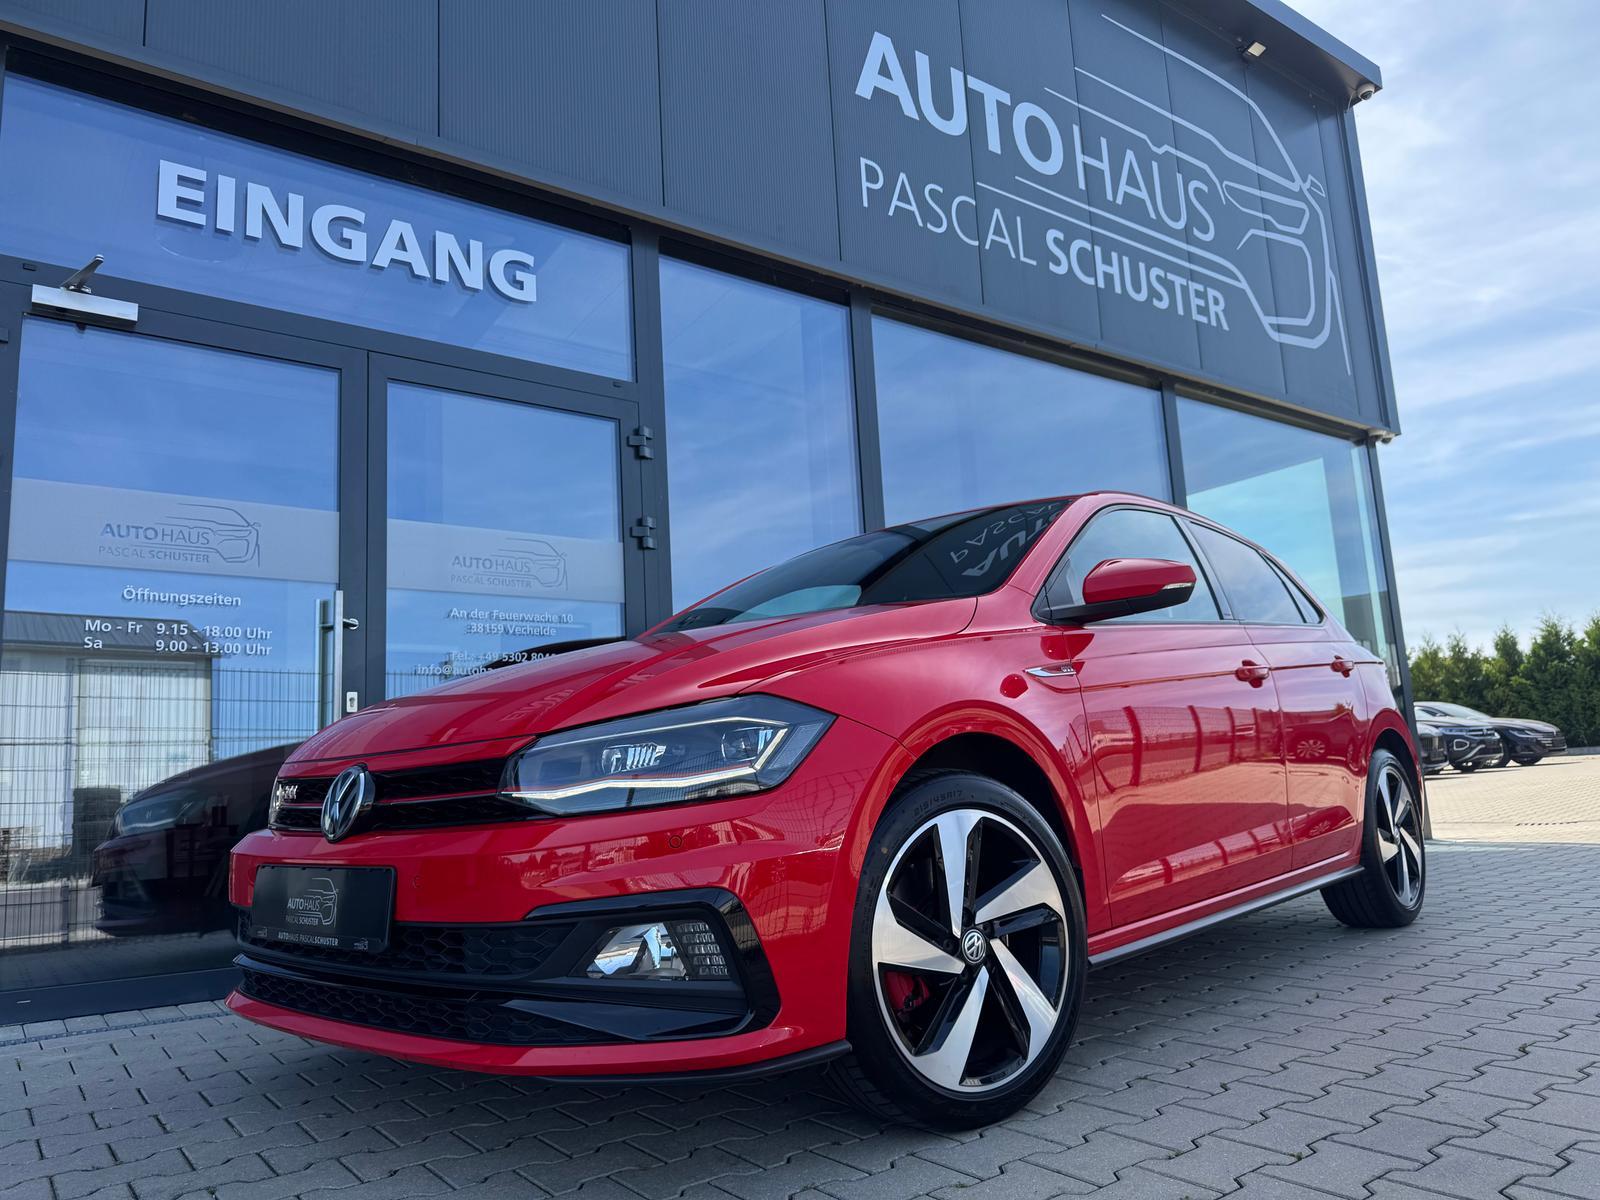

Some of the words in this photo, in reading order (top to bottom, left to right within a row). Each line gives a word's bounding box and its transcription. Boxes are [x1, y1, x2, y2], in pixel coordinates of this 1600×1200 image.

[157, 159, 537, 302] EINGANG
[860, 157, 1037, 267] PASCAL
[1046, 229, 1229, 331] SCHUSTER
[99, 545, 145, 559] PASCAL
[149, 550, 210, 564] SCHUSTER
[451, 574, 484, 585] PASCAL
[487, 577, 532, 588] SCHUSTER
[123, 585, 241, 609] Öffnungszeiten
[451, 607, 467, 619] An
[470, 608, 490, 620] der
[493, 609, 559, 623] Feuerwache
[561, 613, 574, 624] 10
[85, 619, 112, 633] Mo
[127, 621, 143, 634] Fr
[156, 622, 188, 636] 9.15
[204, 625, 242, 639] 18.00
[246, 627, 273, 640] Uhr
[470, 623, 504, 634] 38159
[508, 624, 557, 636] Vechelde
[83, 636, 103, 650] Sa
[155, 639, 188, 653] 9.00
[202, 641, 242, 655] 13.00
[246, 643, 273, 656] Uhr
[502, 652, 528, 663] 5302
[298, 916, 319, 926] SCHUSTER
